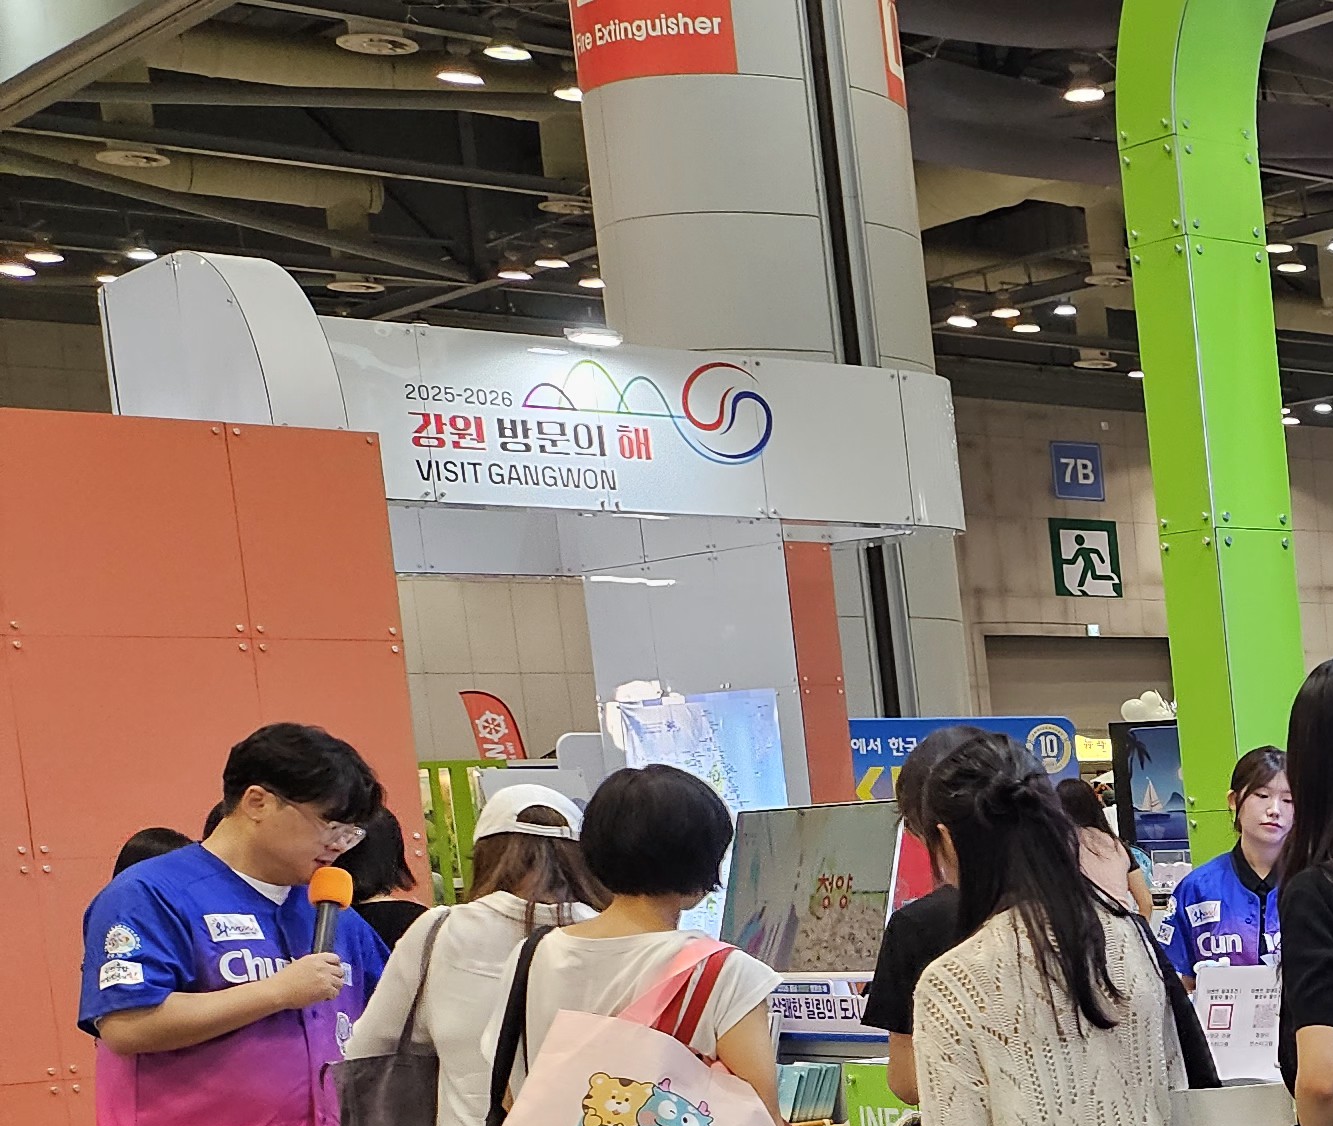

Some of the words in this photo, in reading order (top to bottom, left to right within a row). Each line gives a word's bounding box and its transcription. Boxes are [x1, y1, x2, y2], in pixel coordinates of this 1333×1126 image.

[575, 32, 592, 55] Fire
[594, 12, 722, 46] Extinguisher
[404, 383, 513, 407] 2025-2026
[407, 411, 487, 451] 강원
[496, 418, 608, 457] 방문의
[616, 424, 653, 461] 해
[415, 459, 482, 484] VISIT
[488, 462, 618, 491] GANGWON
[1059, 457, 1095, 485] 7B
[850, 737, 882, 755] 에서
[1038, 734, 1059, 757] 10
[816, 873, 853, 910] 청양
[804, 997, 837, 1020] 힐링의
[840, 998, 861, 1020] 도시
